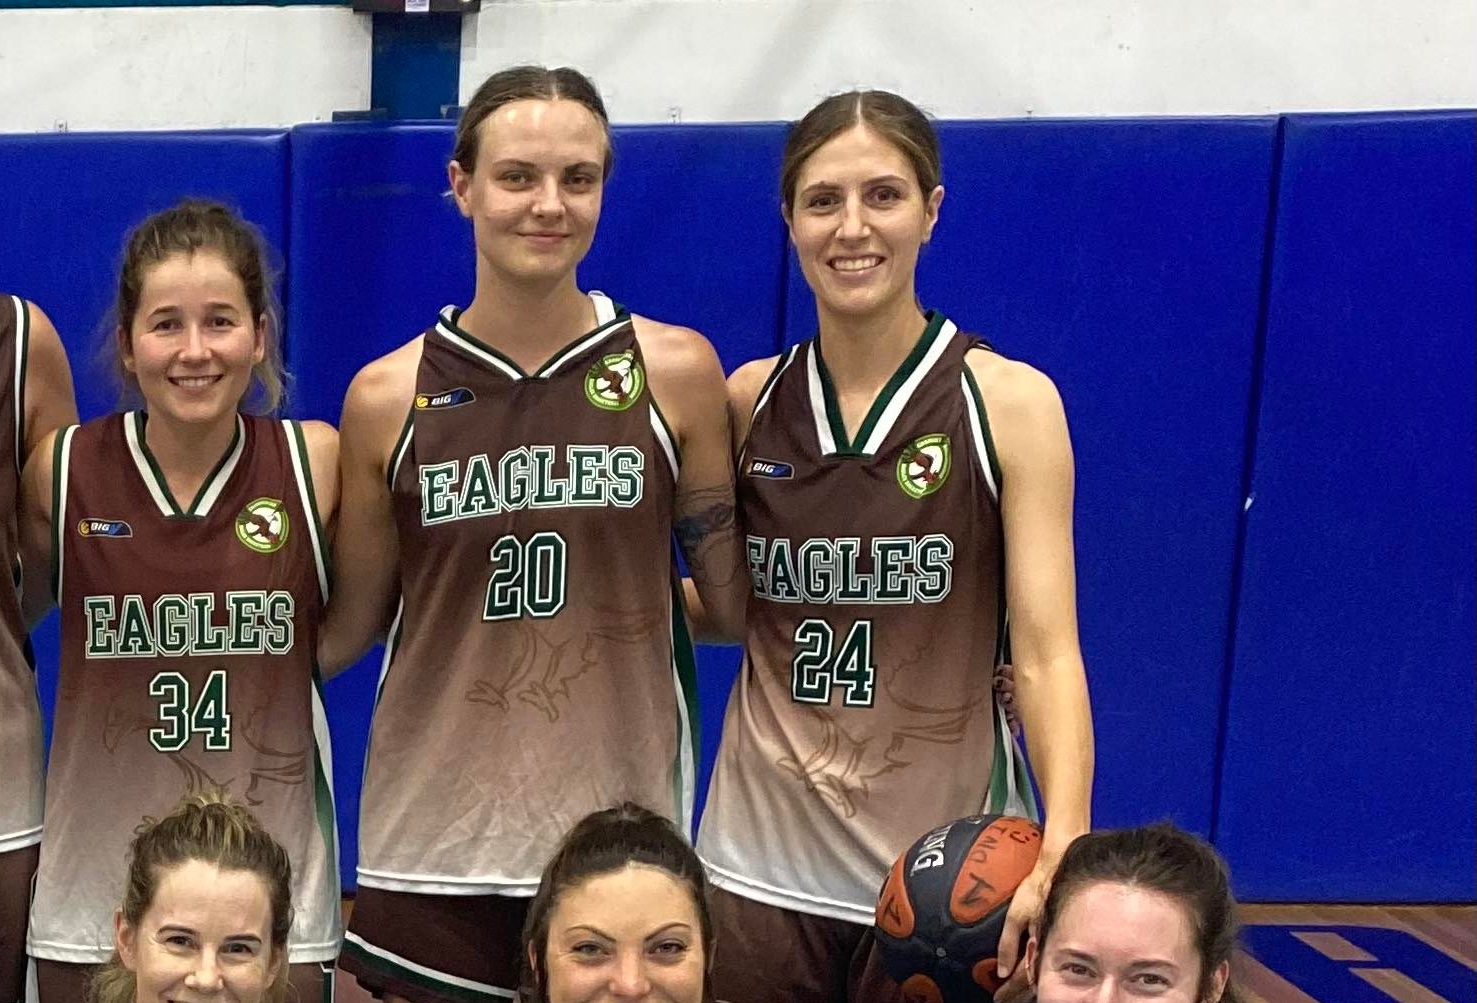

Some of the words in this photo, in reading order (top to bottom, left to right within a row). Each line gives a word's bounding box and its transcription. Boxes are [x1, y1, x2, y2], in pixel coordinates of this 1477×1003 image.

[419, 445, 644, 526] EAGLES
[483, 532, 566, 621] 20
[746, 533, 954, 604] EAGLES
[84, 590, 295, 659] EAGLES
[793, 619, 874, 705] 24
[149, 670, 232, 751] 34
